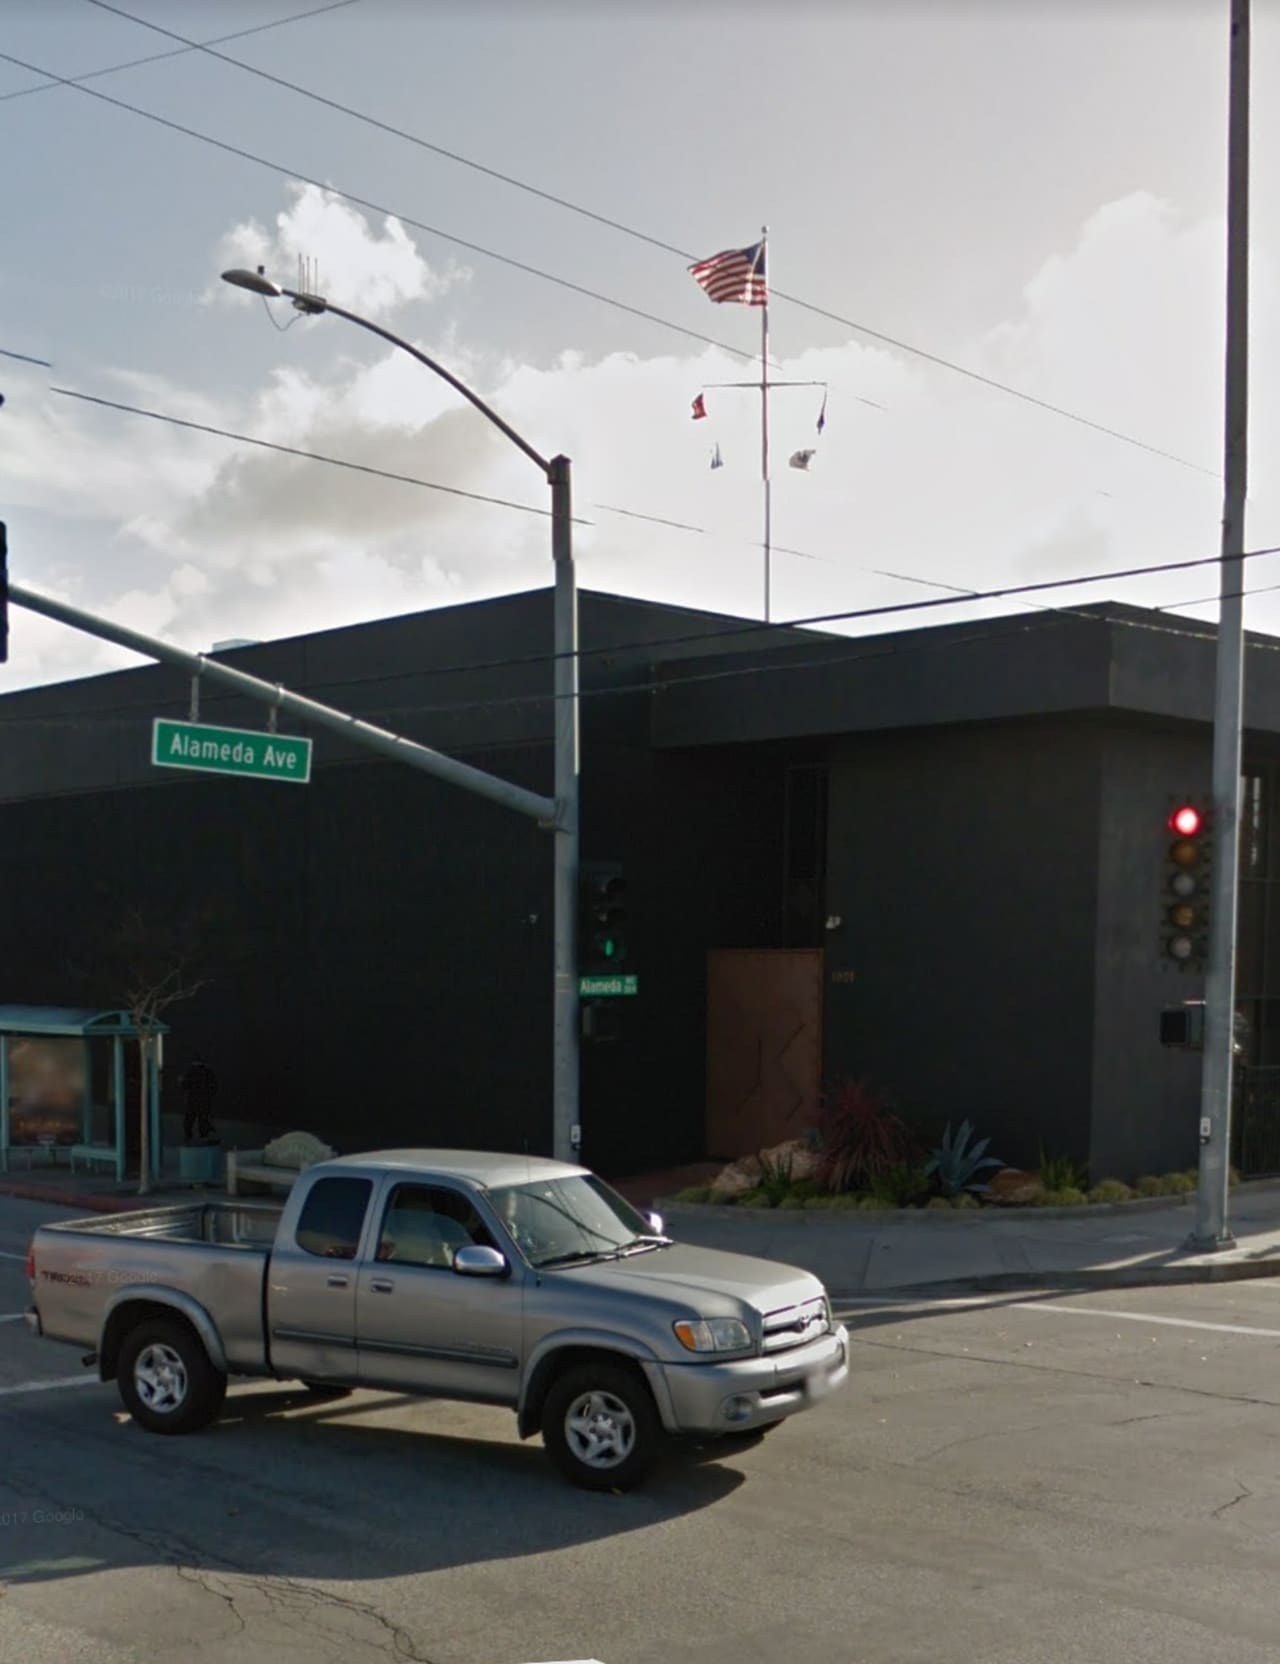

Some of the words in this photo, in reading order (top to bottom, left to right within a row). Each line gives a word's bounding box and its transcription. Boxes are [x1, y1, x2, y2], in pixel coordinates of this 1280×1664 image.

[170, 732, 254, 765] Alameda
[263, 744, 297, 769] Ave
[580, 978, 622, 993] Alameda
